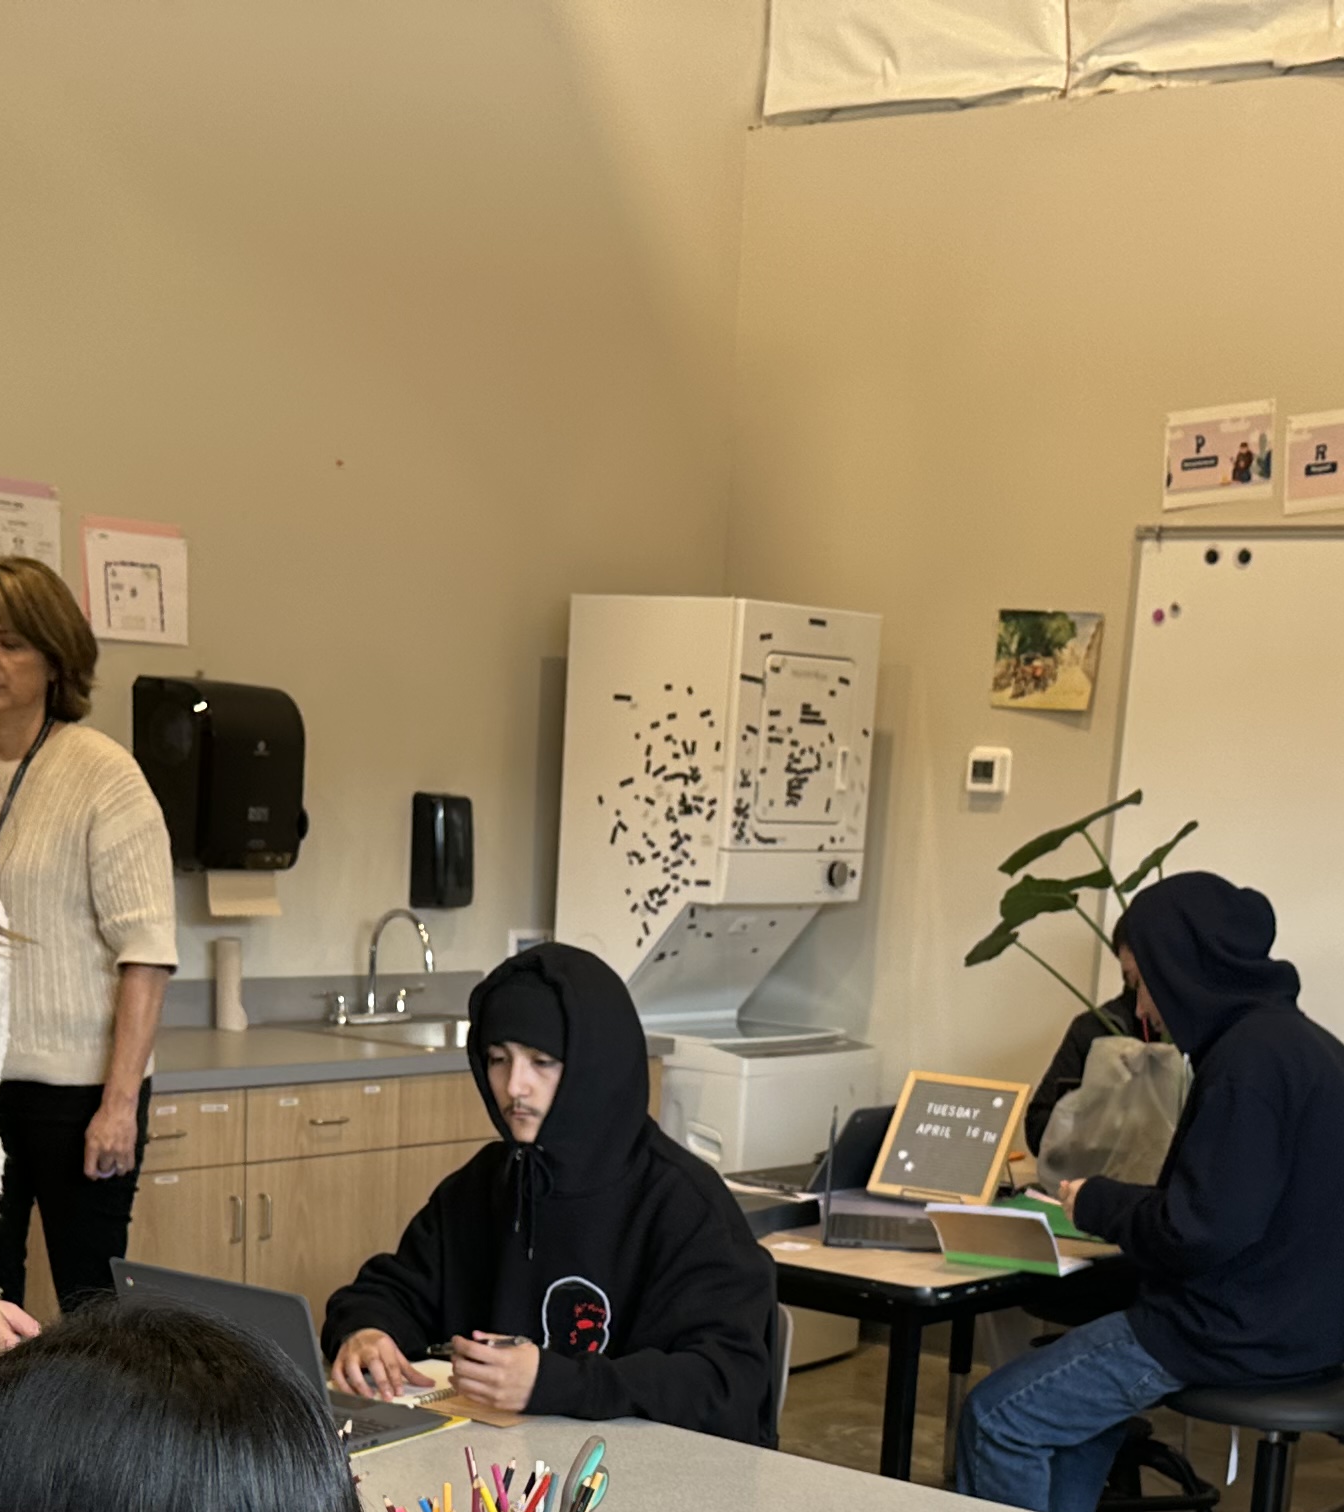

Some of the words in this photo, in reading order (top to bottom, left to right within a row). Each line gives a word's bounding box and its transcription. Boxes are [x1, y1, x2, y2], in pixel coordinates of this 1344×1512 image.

[1194, 433, 1206, 454] P
[1314, 443, 1328, 461] R
[926, 1101, 982, 1121] TUESDAY
[915, 1122, 953, 1140] APRIL
